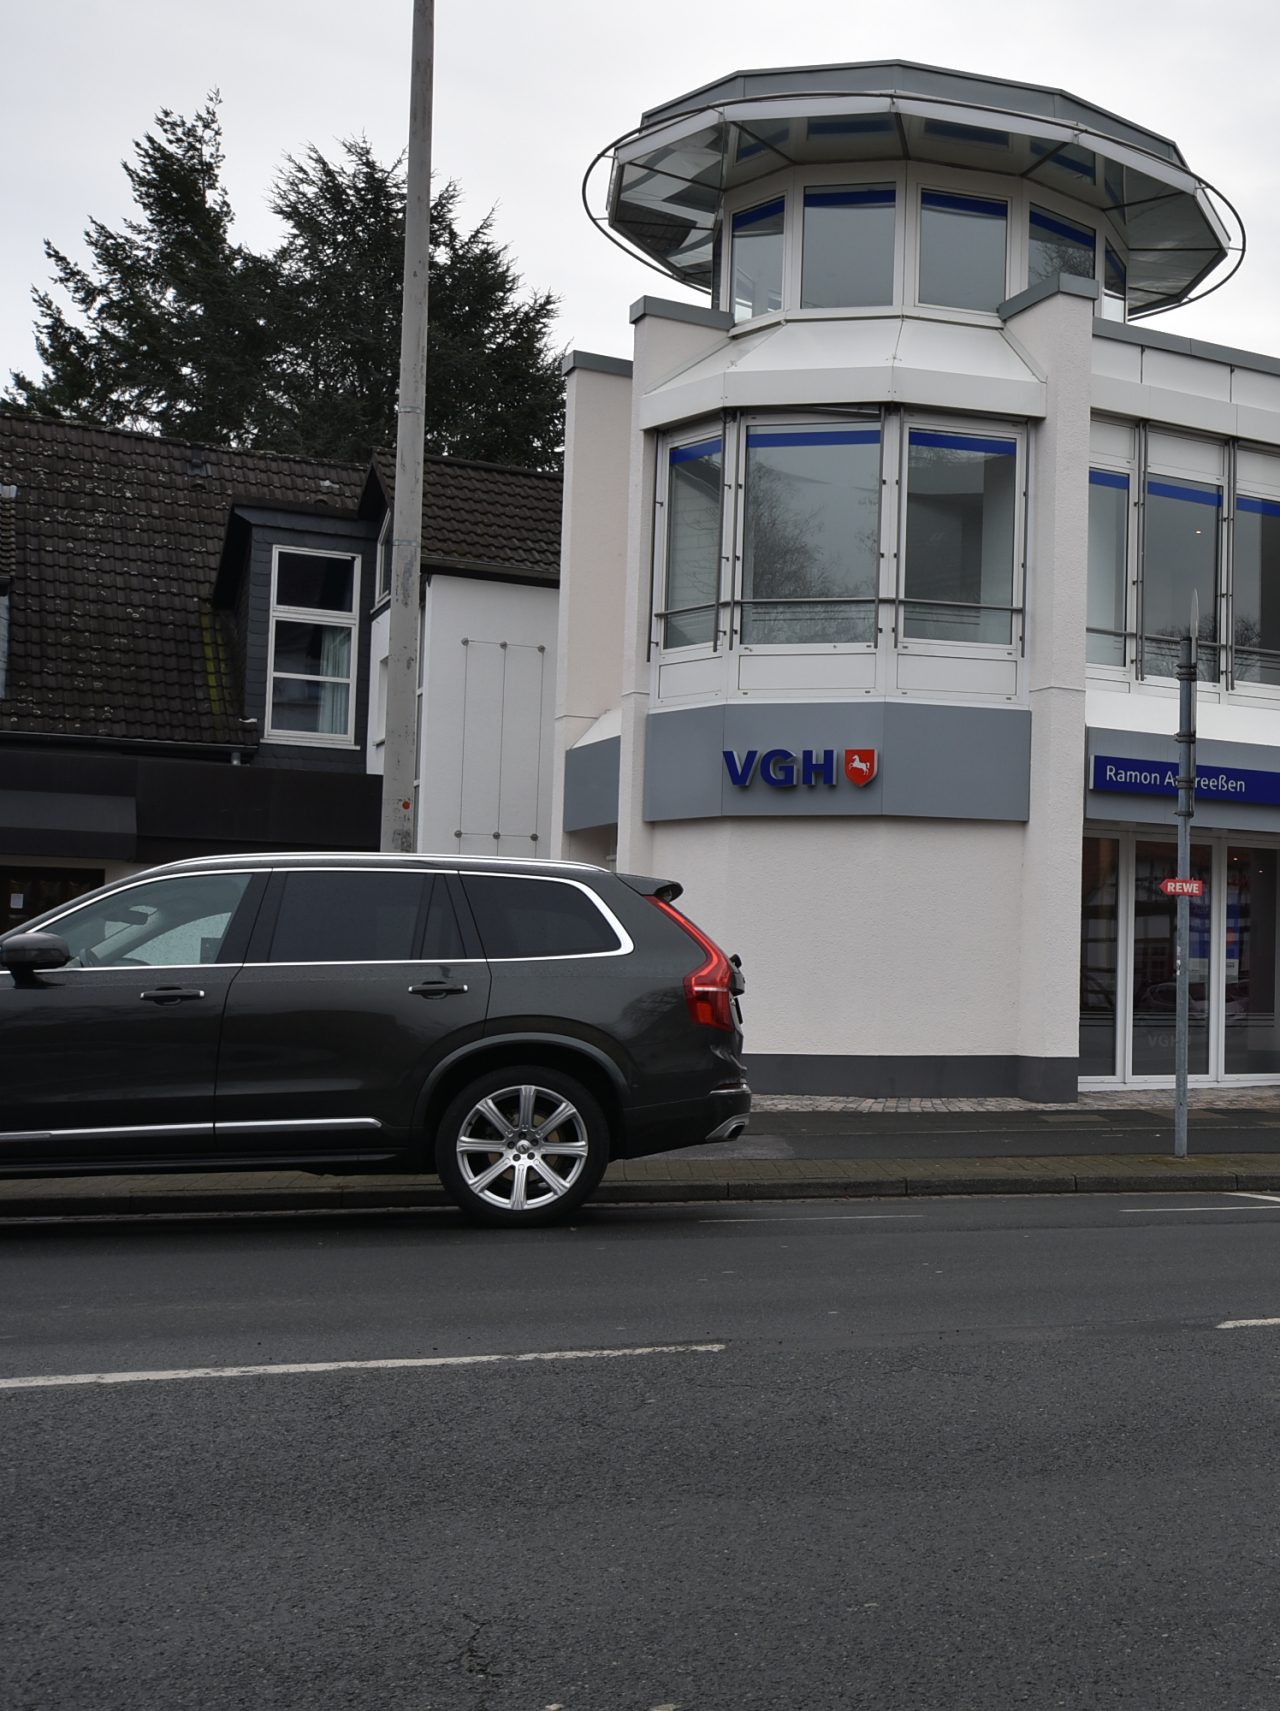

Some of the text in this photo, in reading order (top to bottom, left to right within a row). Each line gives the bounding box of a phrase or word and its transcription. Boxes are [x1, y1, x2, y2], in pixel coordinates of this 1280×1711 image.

[722, 748, 837, 787] VGH
[1106, 765, 1246, 793] Ramon Areeßen
[1167, 882, 1200, 894] REWE
